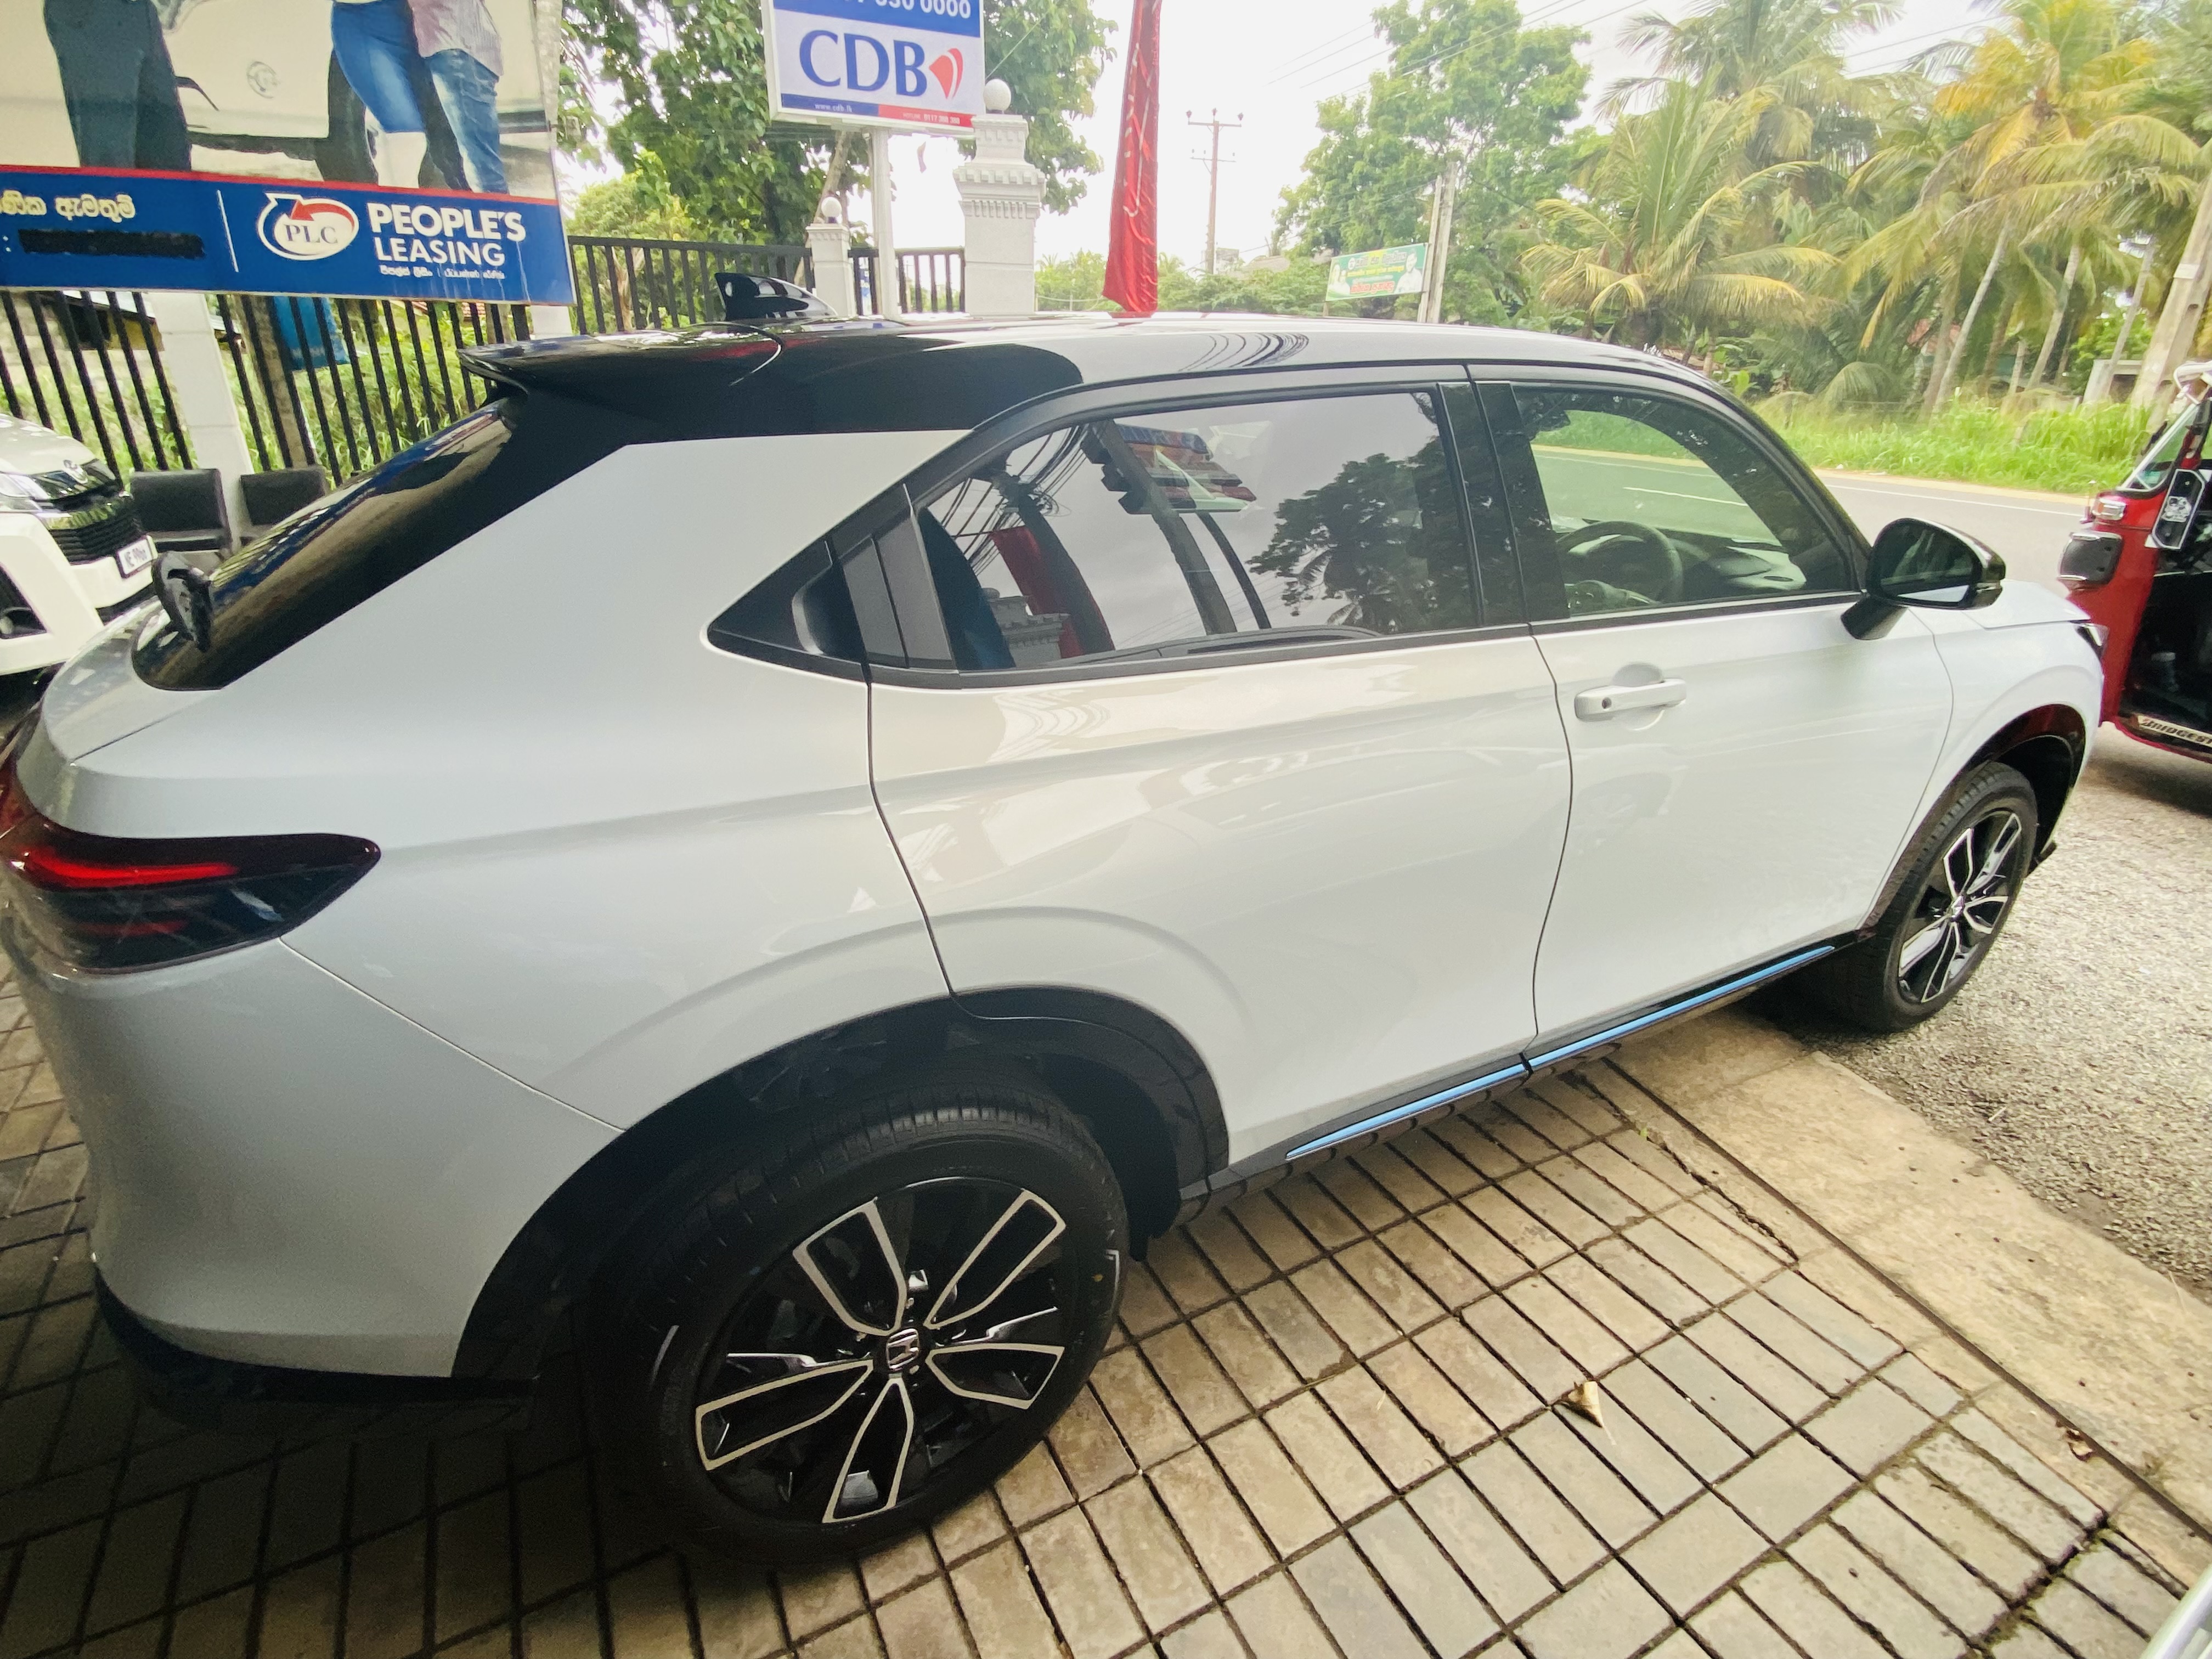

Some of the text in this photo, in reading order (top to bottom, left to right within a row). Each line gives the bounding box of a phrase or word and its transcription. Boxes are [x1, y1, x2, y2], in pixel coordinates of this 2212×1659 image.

[799, 30, 928, 97] CDB
[284, 224, 338, 244] PLC
[367, 202, 526, 242] PEOPLE'S
[374, 237, 505, 266] LEASING
